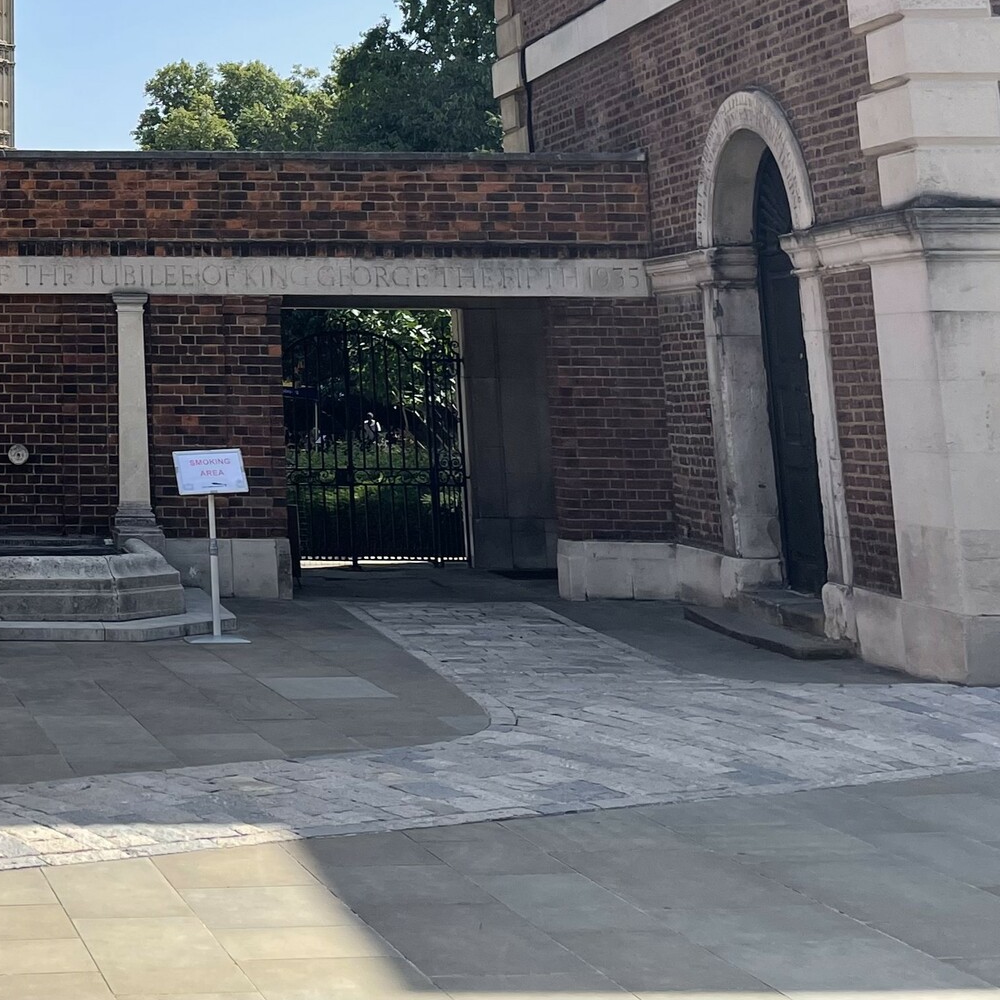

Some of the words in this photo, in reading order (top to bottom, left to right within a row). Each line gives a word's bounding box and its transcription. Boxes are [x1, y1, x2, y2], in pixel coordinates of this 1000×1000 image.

[18, 264, 75, 287] THE
[85, 264, 194, 287] JUBILEE
[201, 264, 239, 286] OF
[243, 264, 310, 288] KING
[316, 264, 431, 288] GEORGE
[432, 265, 493, 287] THE
[500, 265, 579, 288] FIFTH
[586, 266, 640, 288] 1935
[189, 458, 231, 467] SMOKING
[200, 469, 225, 477] AREA
